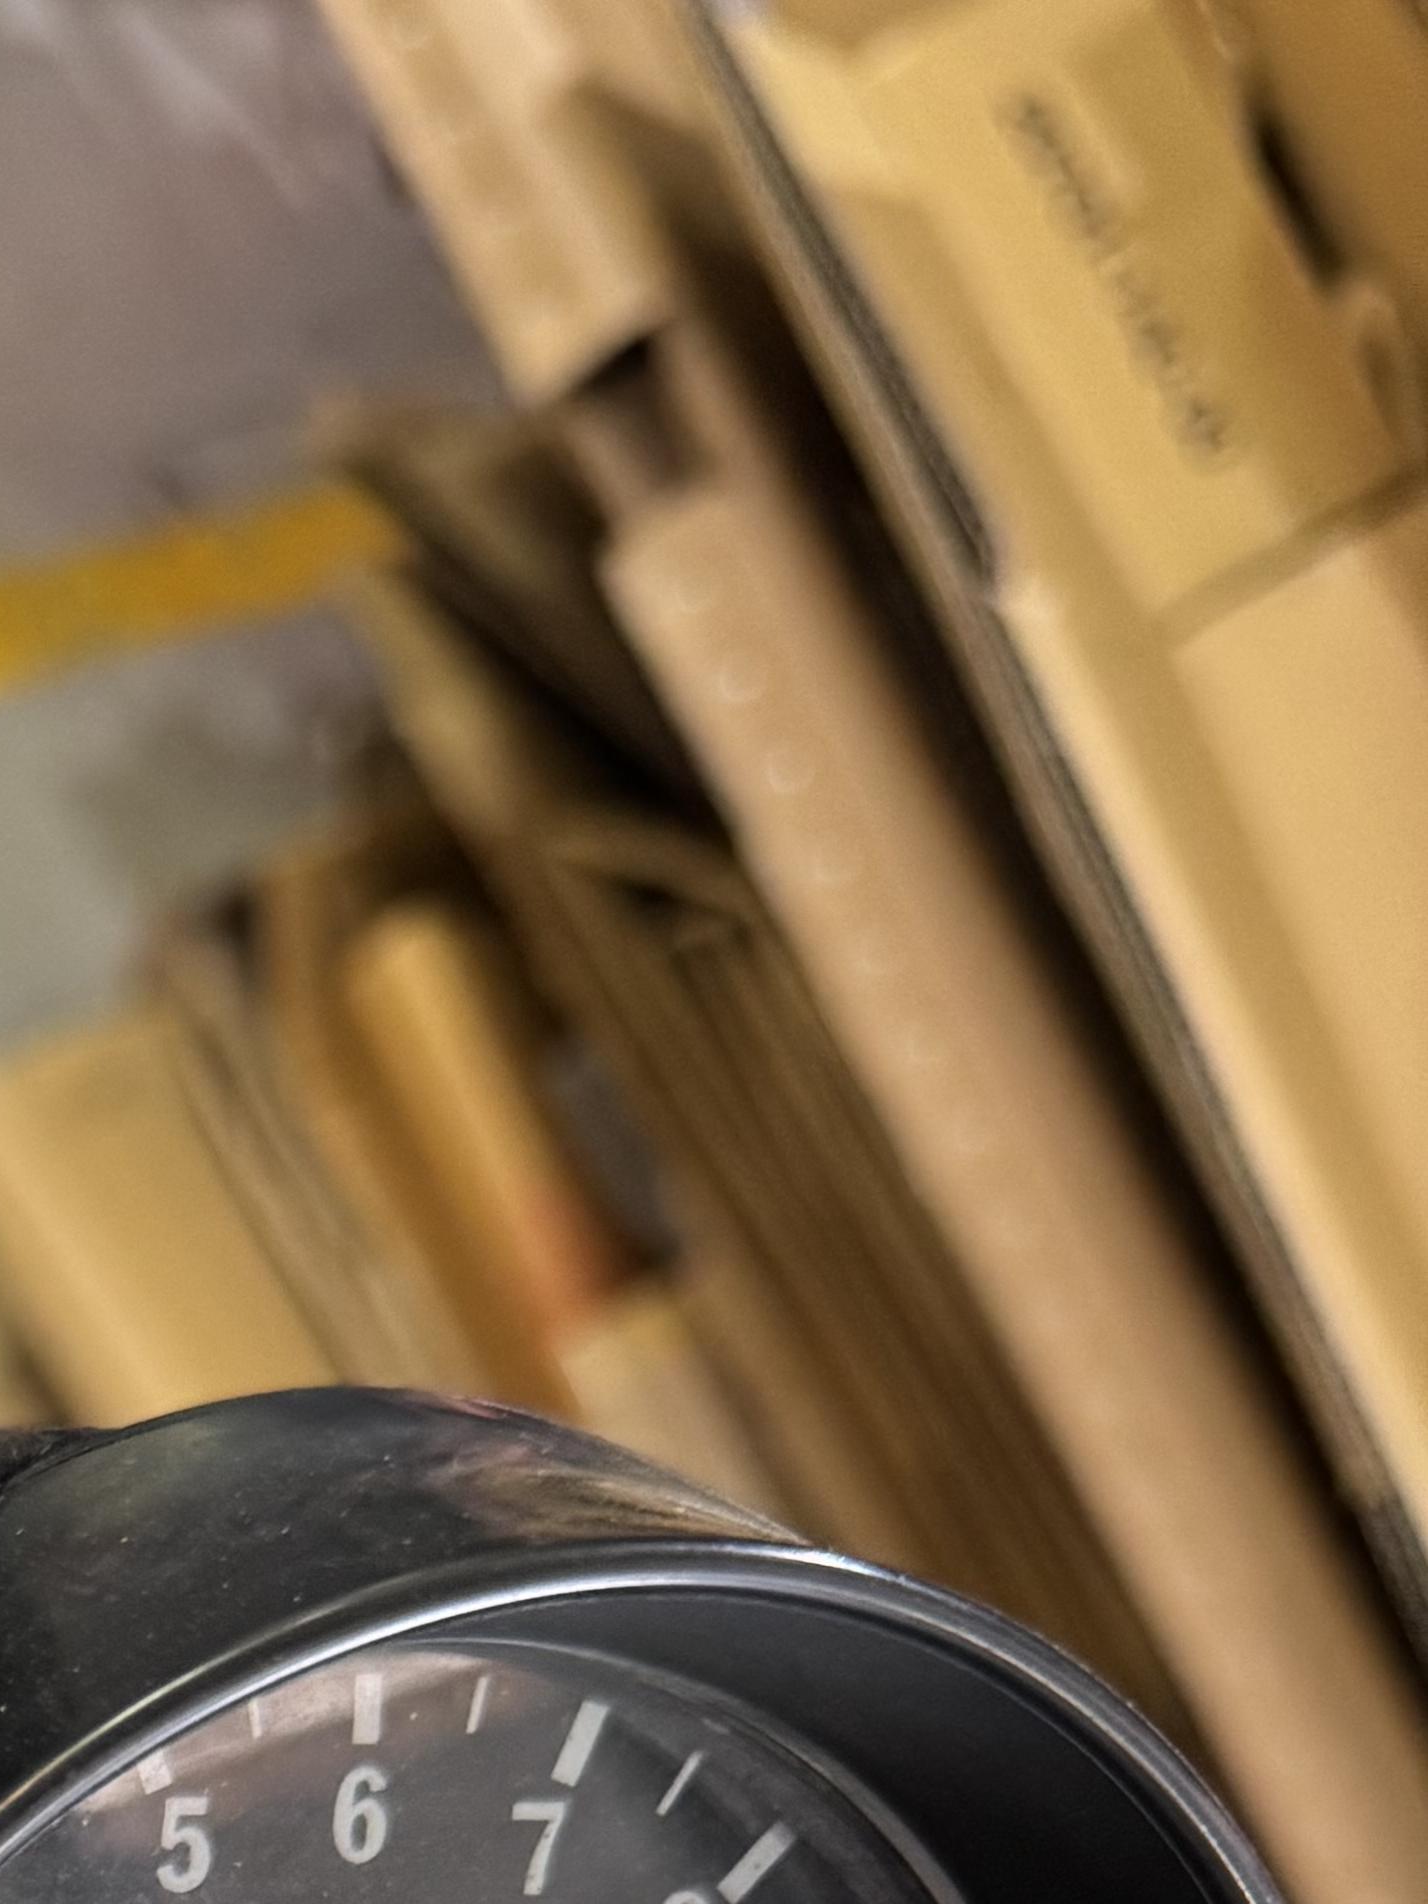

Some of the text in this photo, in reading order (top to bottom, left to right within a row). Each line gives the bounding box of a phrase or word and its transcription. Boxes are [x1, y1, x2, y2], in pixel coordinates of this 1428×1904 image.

[156, 1799, 211, 1894] 5
[334, 1766, 387, 1864] 6
[512, 1801, 568, 1896] 7
